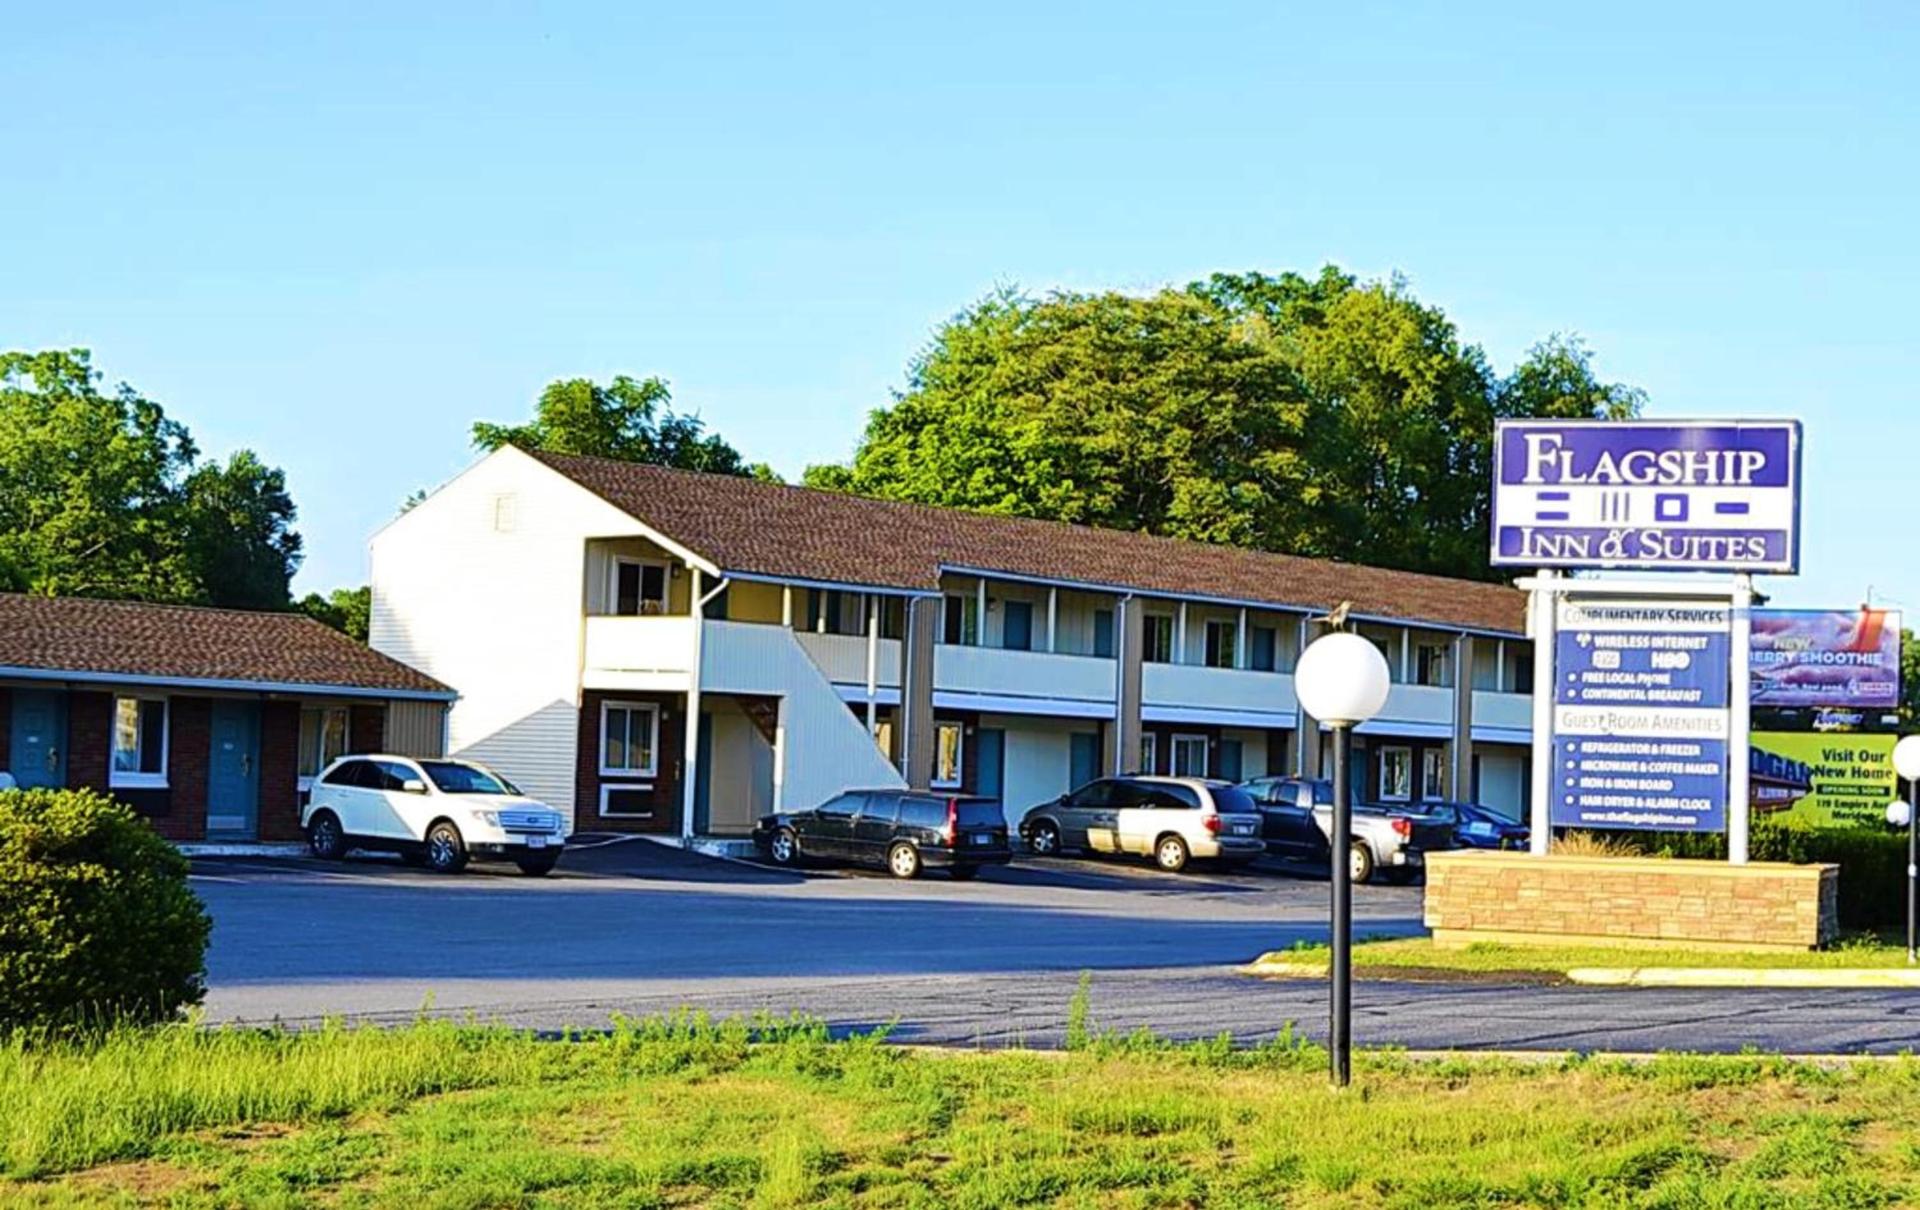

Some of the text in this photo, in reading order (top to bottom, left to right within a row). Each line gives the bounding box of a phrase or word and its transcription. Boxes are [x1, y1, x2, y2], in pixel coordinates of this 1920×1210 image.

[1522, 432, 1767, 485] FLAGSHIP
[1520, 527, 1766, 562] INN & SUITES
[1564, 606, 1723, 624] COMPLIMENTARY SERVICES
[1593, 635, 1708, 650] WIRELESS INTERNET
[1651, 651, 1690, 669] HBO
[1800, 651, 1884, 666] SMOOTHIE
[1581, 672, 1671, 686] FREE LOCAL PHONE
[1581, 687, 1702, 702] CONTINENTAL BREAKFAST
[1562, 711, 1723, 733] GUEST ROOM AMENITIES
[1580, 742, 1650, 755] REFRIGERATOR
[1660, 744, 1701, 757] FREEZER
[1822, 749, 1886, 763] Visit Our
[1580, 760, 1638, 773] MICROWAVE
[1648, 762, 1684, 775] COFFEE
[1685, 763, 1720, 776] MAKER
[1814, 764, 1893, 780] New Home
[1580, 777, 1604, 789] IRON
[1613, 778, 1638, 791] IRON
[1639, 779, 1674, 792] BOARD
[1579, 795, 1604, 807] HAIR
[1604, 796, 1635, 808] DRYER
[1645, 797, 1680, 810] ALARM
[1681, 798, 1712, 811] CLOCK
[1834, 799, 1869, 809] Empire
